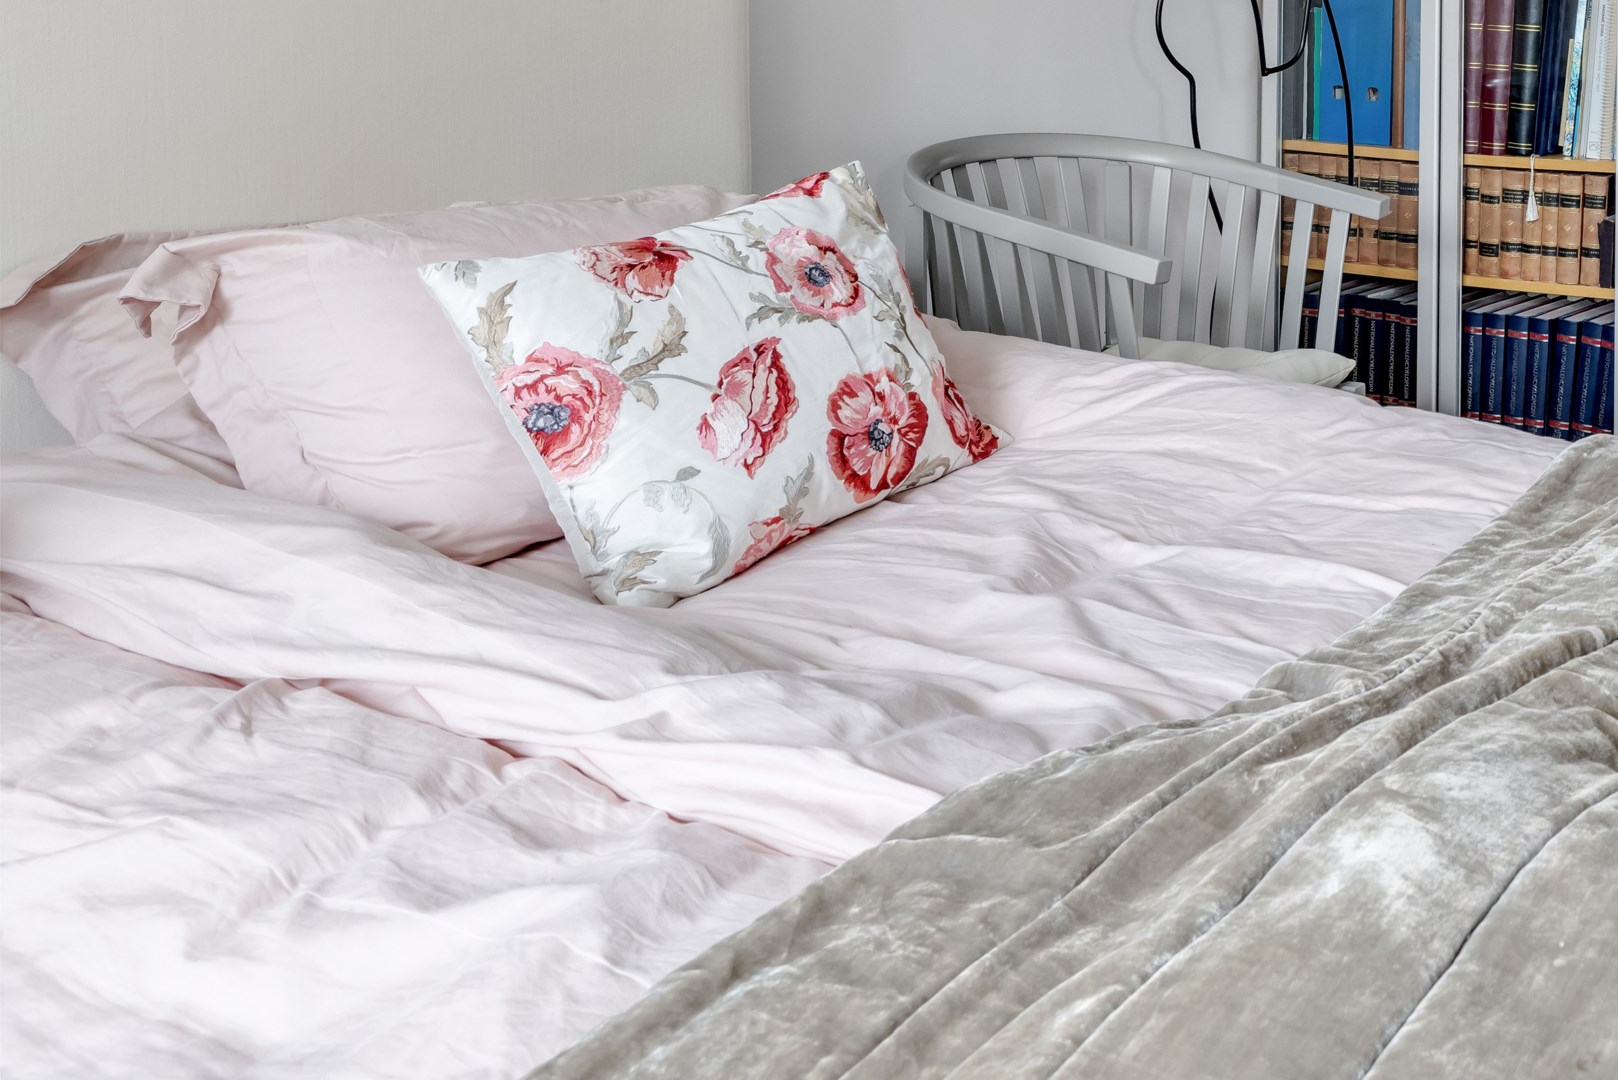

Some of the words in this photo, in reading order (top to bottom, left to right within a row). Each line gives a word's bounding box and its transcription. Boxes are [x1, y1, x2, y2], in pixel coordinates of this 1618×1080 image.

[1388, 322, 1396, 395] NATIONALENCYKLOPEDIN
[1403, 326, 1411, 400] NATIONALENCYKLOPEDIN
[1467, 335, 1475, 409] NATIONALENCYKLOPEDIN
[1488, 337, 1498, 412] NATIONALENCYKLOPEDIN
[1530, 342, 1541, 417] NATIONALENCYKLOPEDIN
[1555, 344, 1568, 420] NATIONALENCYKLOPEDIN
